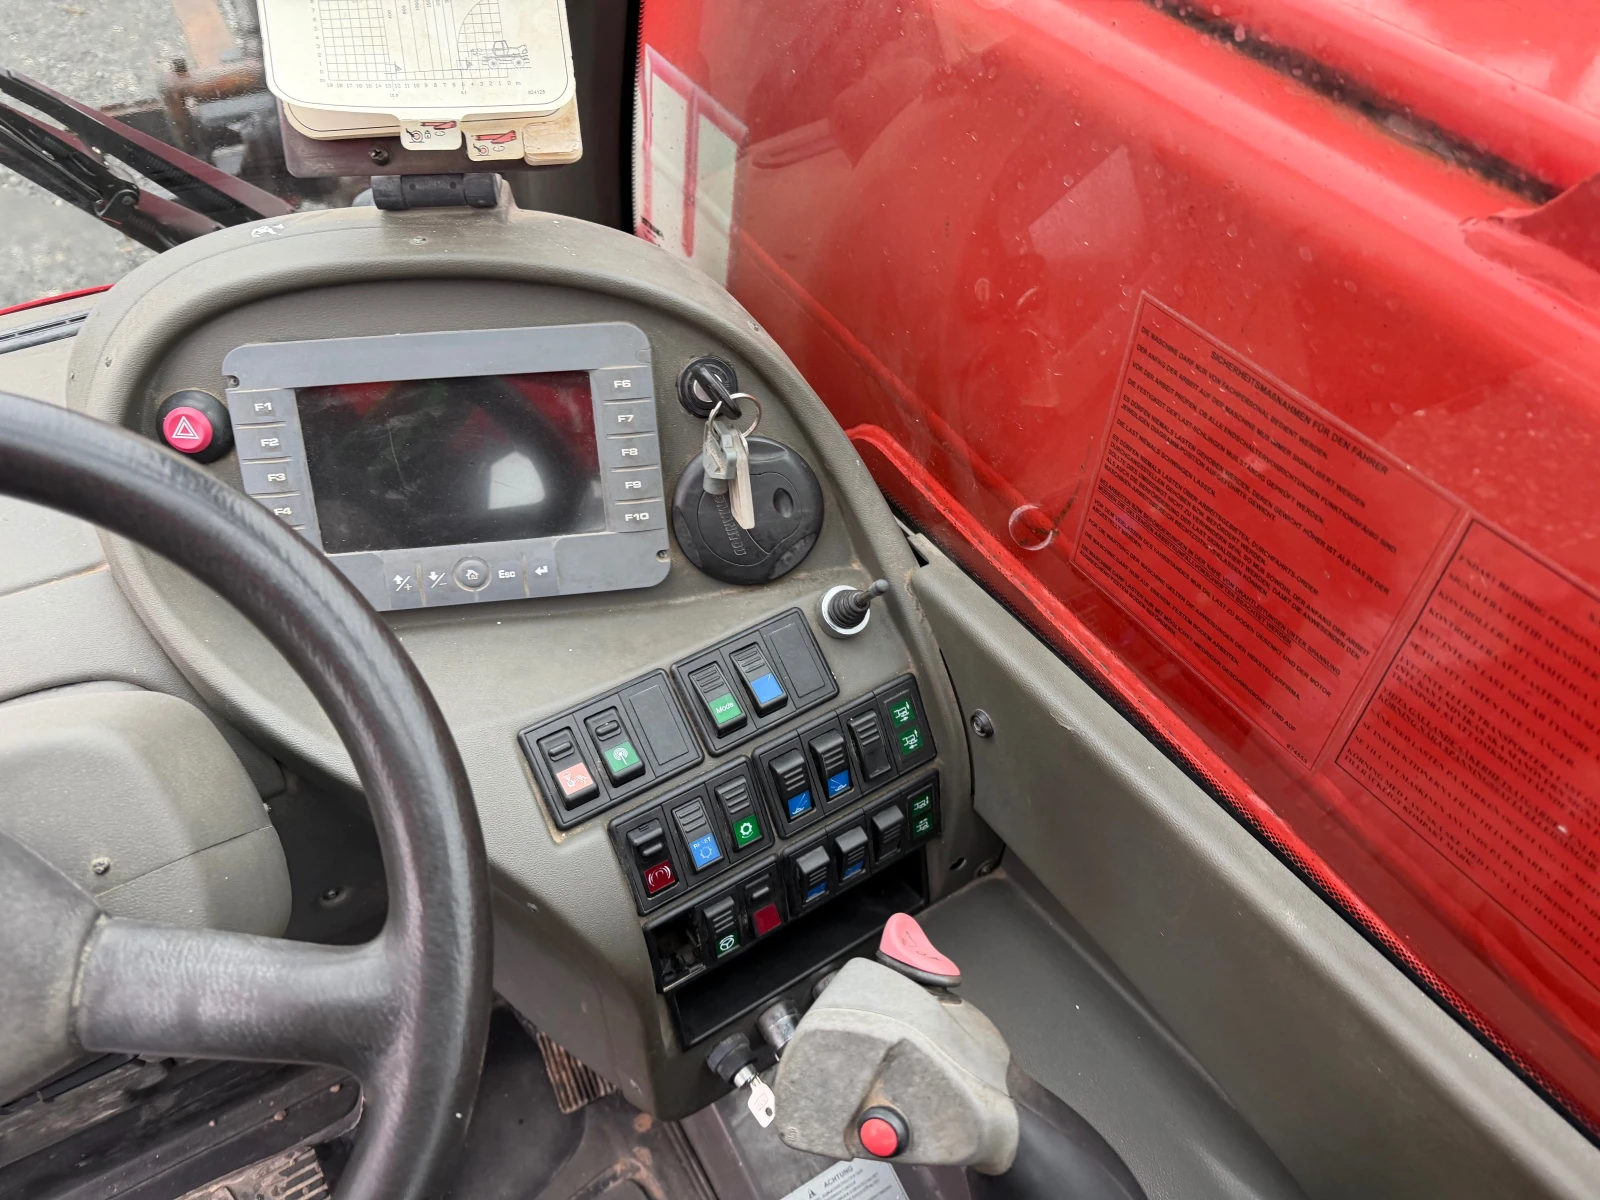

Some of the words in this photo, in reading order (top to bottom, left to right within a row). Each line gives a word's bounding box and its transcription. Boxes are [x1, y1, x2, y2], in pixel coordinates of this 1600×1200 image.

[613, 379, 631, 389] F6
[1140, 325, 1150, 336] DIE
[1150, 332, 1178, 356] MASCHINE
[1178, 351, 1194, 367] DARF
[1194, 362, 1207, 376] NUR
[1207, 372, 1221, 385] VON
[1221, 381, 1269, 419] FACHPERSONAL
[1269, 415, 1298, 439] BEDIENT
[254, 402, 273, 412] F1
[617, 414, 635, 424] F7
[260, 437, 279, 448] F2
[1311, 417, 1331, 437] FÜR
[1330, 431, 1351, 450] DEN
[1350, 444, 1389, 476] FAHRER
[621, 447, 638, 457] F8
[267, 472, 286, 483] F3
[624, 480, 642, 490] F9
[273, 506, 292, 516] F4
[624, 512, 650, 522] F10
[498, 569, 516, 579] Esc
[715, 701, 735, 715] Mode
[693, 836, 711, 850] RET
[823, 1165, 853, 1188] ACHTUNG
